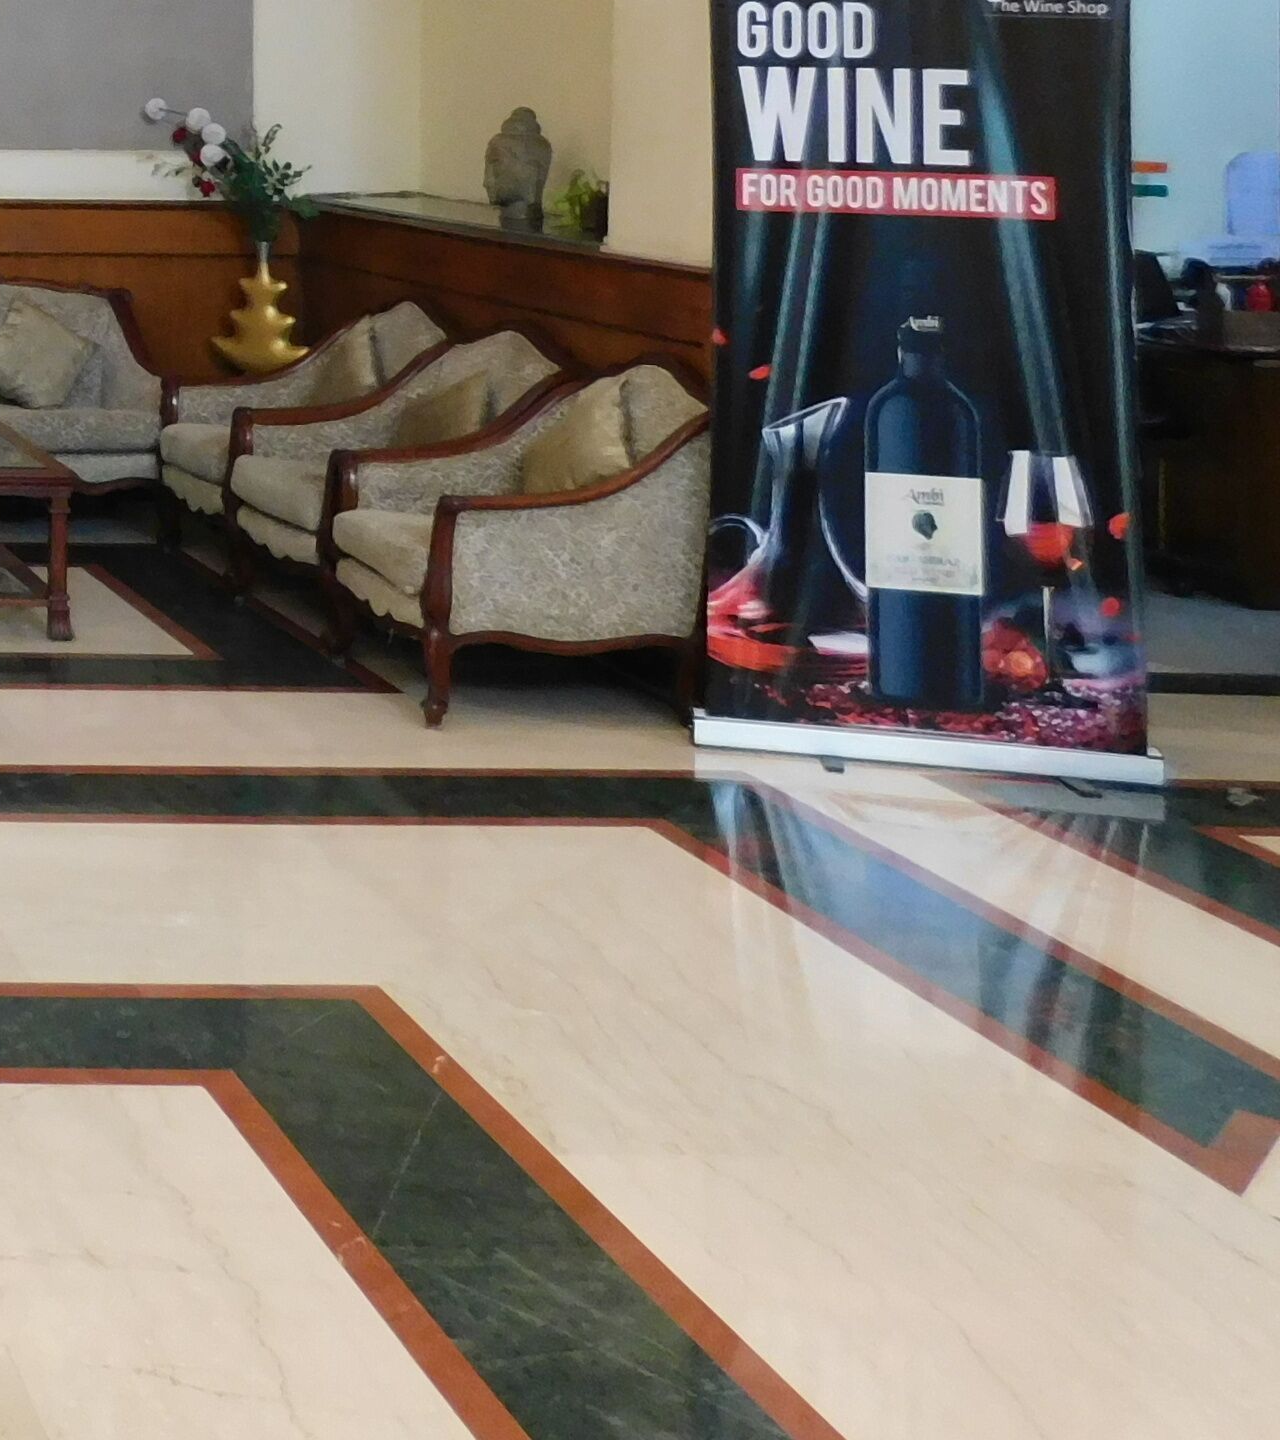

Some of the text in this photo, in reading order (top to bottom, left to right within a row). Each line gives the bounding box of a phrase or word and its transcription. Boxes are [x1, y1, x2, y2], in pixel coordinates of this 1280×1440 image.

[737, 0, 876, 59] GOOD
[1023, 0, 1064, 13] Wine
[1067, 0, 1109, 16] Shop
[738, 66, 971, 167] WINE
[742, 172, 1049, 216] FOR GOOD MOMENTS
